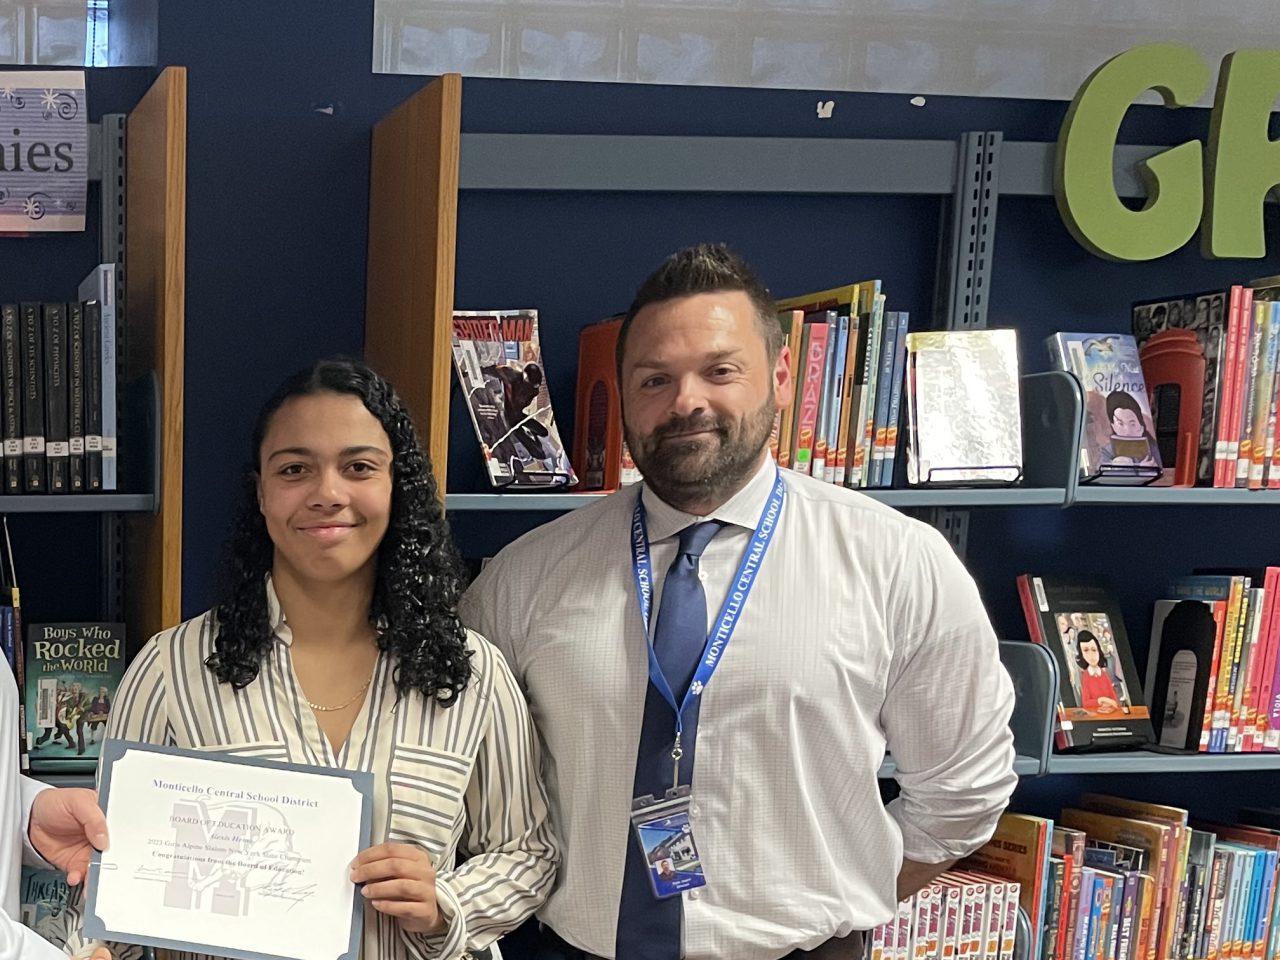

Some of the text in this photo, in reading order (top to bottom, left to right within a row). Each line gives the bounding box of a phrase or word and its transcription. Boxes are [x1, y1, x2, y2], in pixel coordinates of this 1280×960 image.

[453, 318, 534, 342] SPIDER-MAN
[863, 328, 873, 382] CAMOUFLAGE
[1092, 372, 1145, 392] Silence
[706, 591, 743, 668] MONTICELLO
[738, 541, 764, 591] CENTRAL
[759, 501, 780, 539] SCHOOL
[44, 627, 111, 641] Boys Who
[34, 639, 120, 660] Rocked
[43, 663, 59, 671] the
[153, 779, 320, 807] Monticello Central School District
[1120, 917, 1131, 936] BEST
